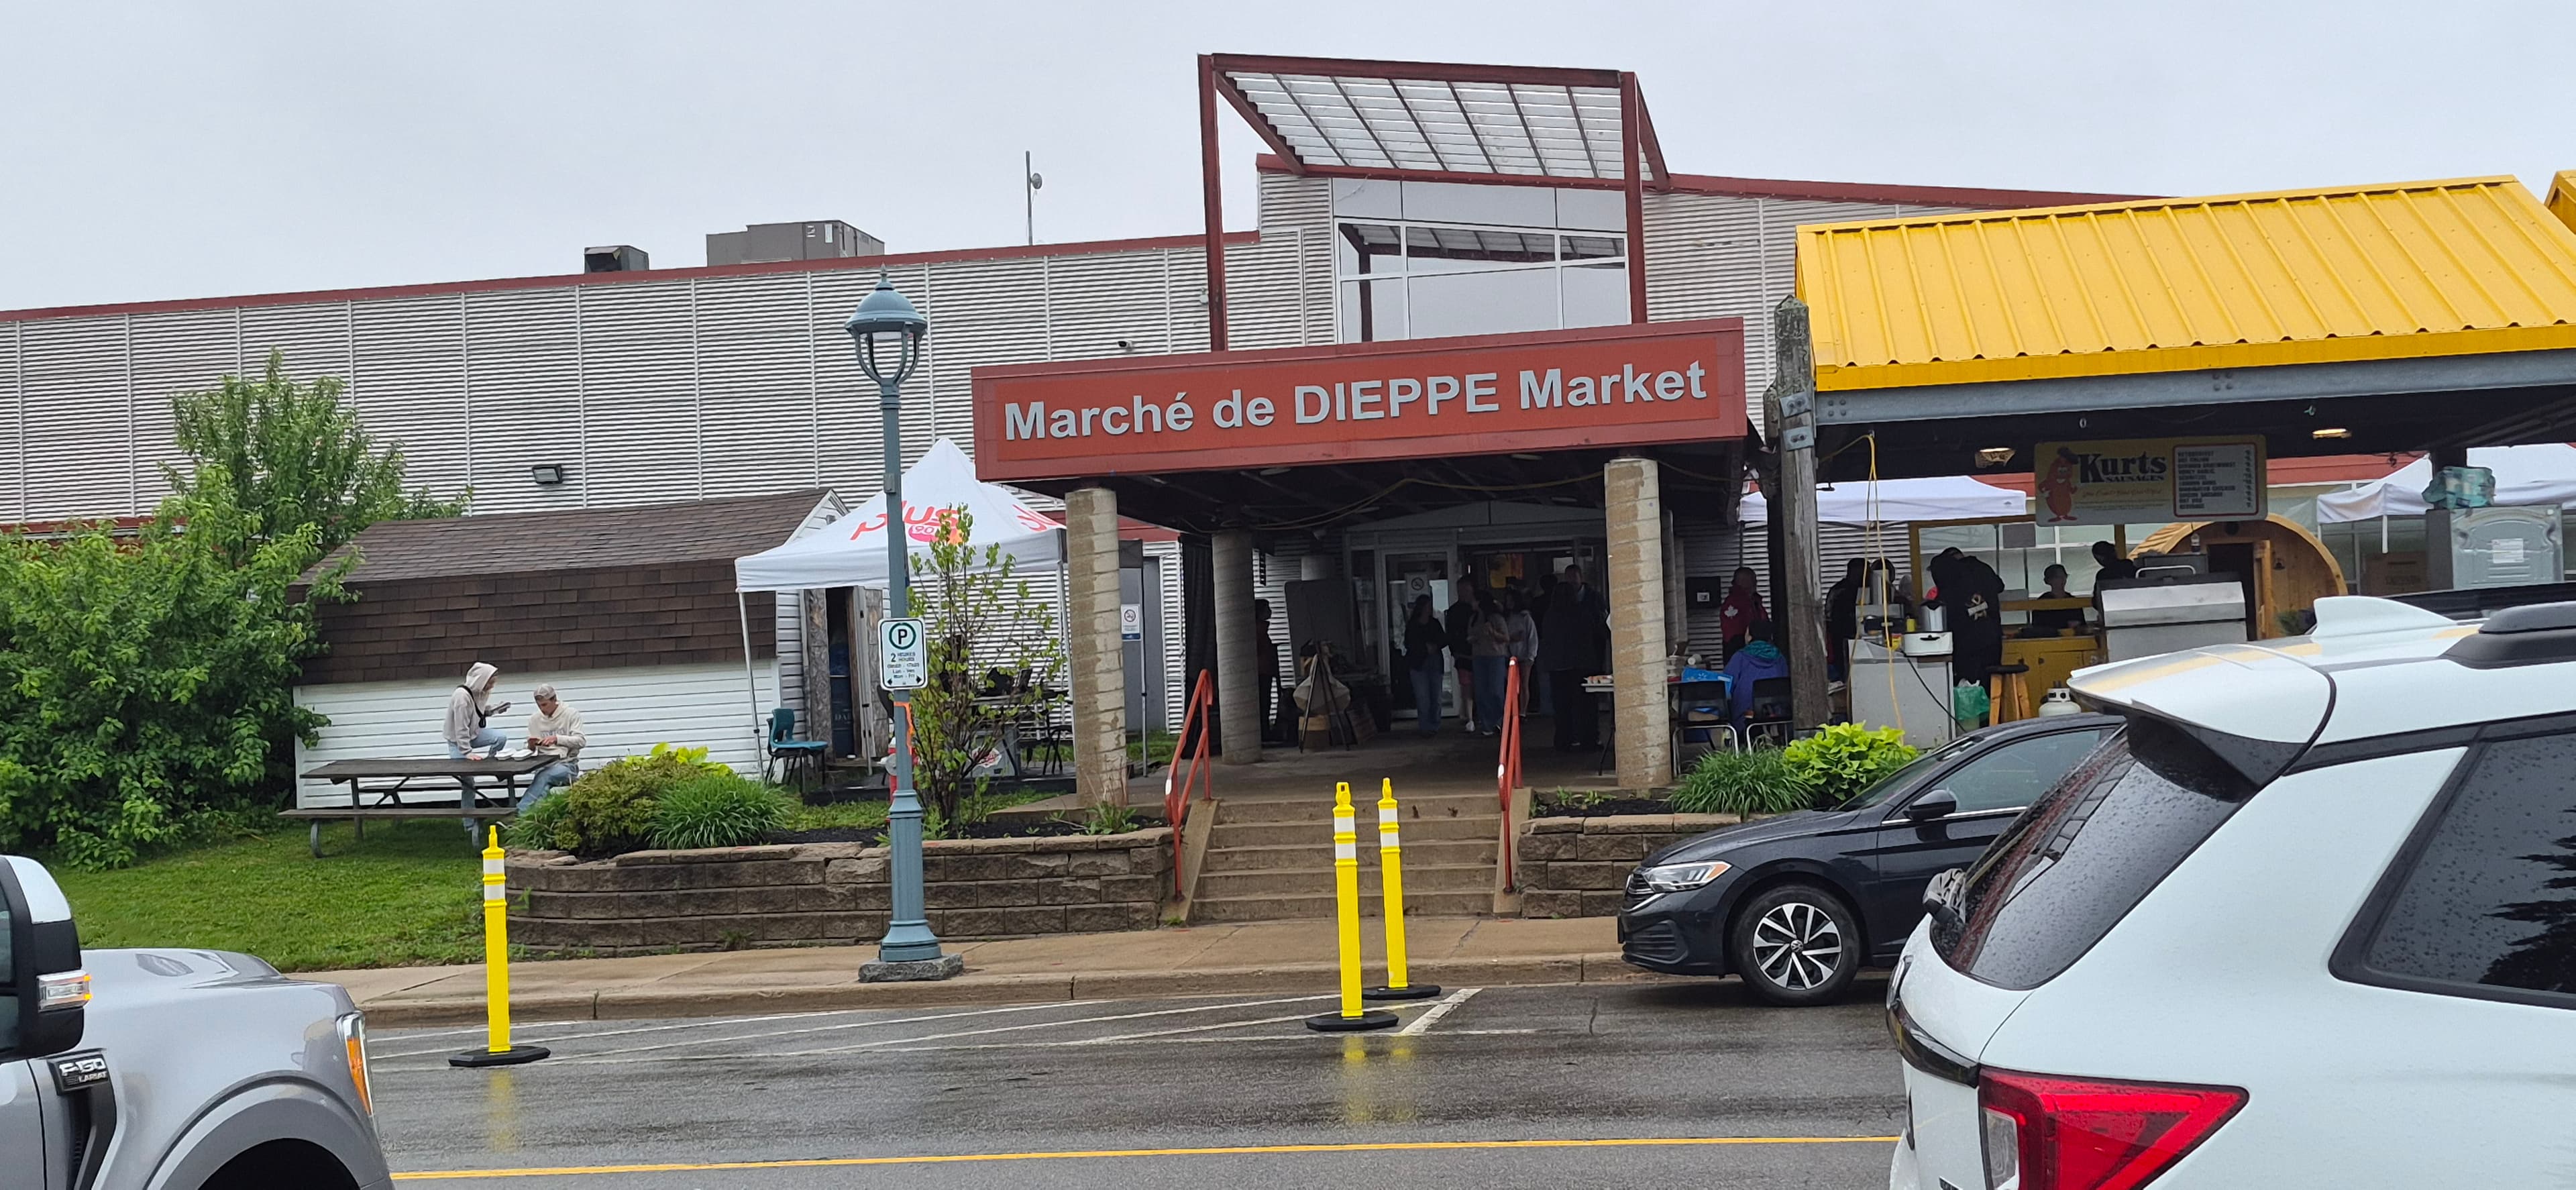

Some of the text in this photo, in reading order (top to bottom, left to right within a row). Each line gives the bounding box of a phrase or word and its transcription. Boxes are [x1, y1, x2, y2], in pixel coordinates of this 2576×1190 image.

[1006, 362, 1708, 440] Marché de DIEPPE Market
[2078, 451, 2167, 483] Kurts
[2104, 474, 2165, 482] SAUSAGES
[898, 629, 908, 645] P
[890, 653, 896, 663] 2
[59, 1058, 107, 1077] F-150
[78, 1071, 107, 1083] LARIAT
